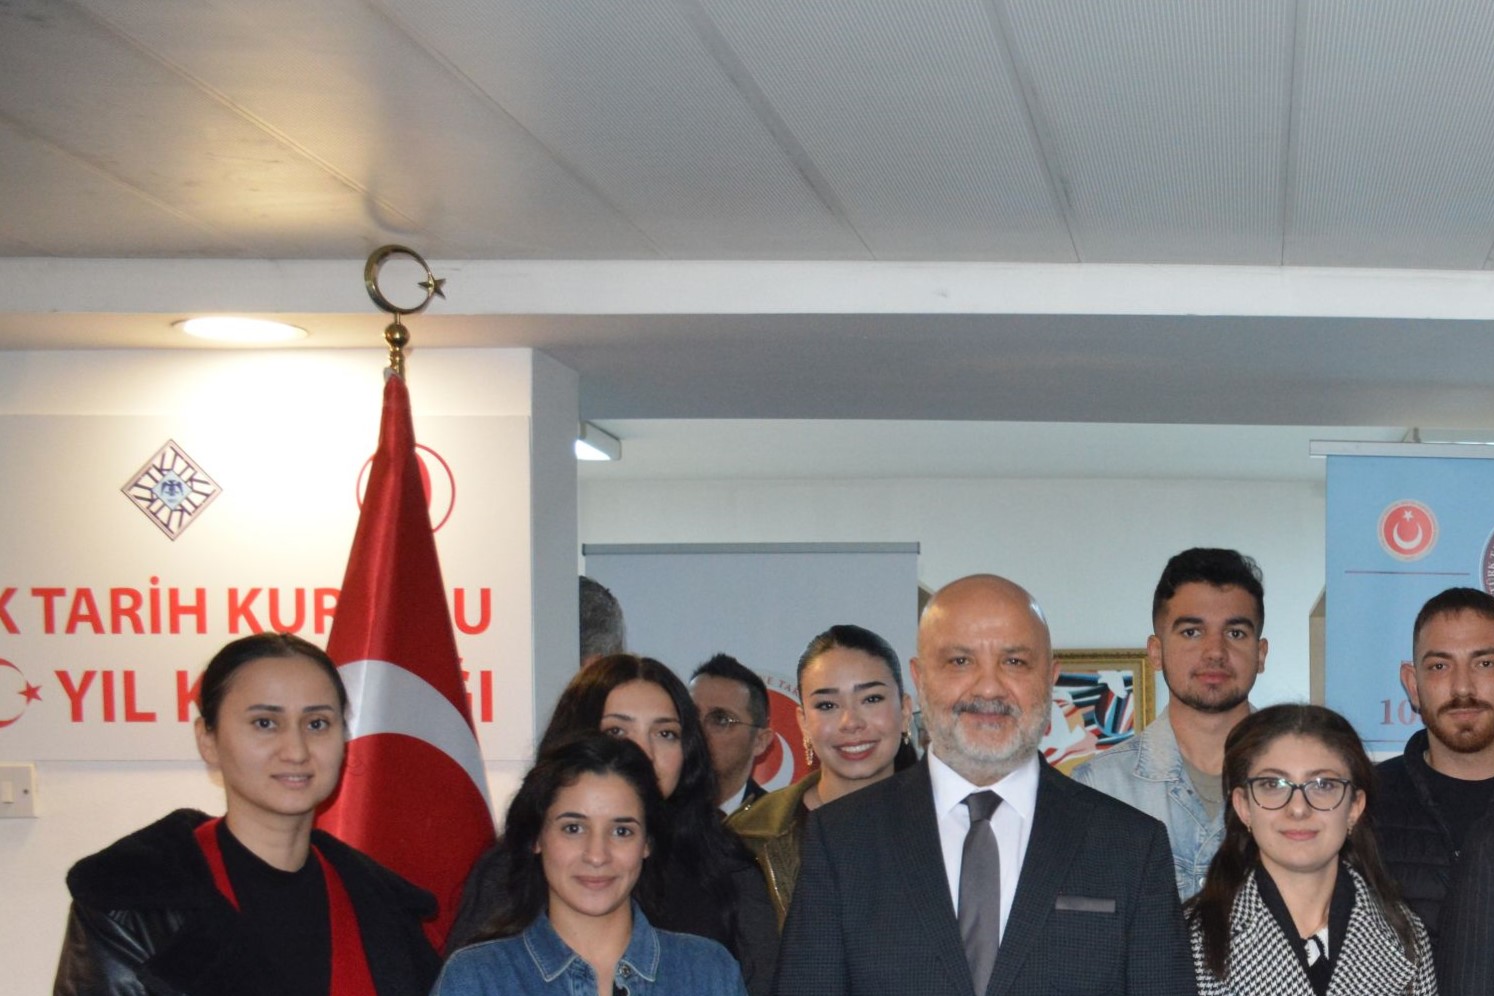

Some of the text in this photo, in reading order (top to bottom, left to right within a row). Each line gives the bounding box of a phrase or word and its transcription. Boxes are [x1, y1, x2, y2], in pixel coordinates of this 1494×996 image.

[31, 576, 207, 635] TARİH
[228, 587, 492, 635] KURU
[54, 670, 157, 723] YIL
